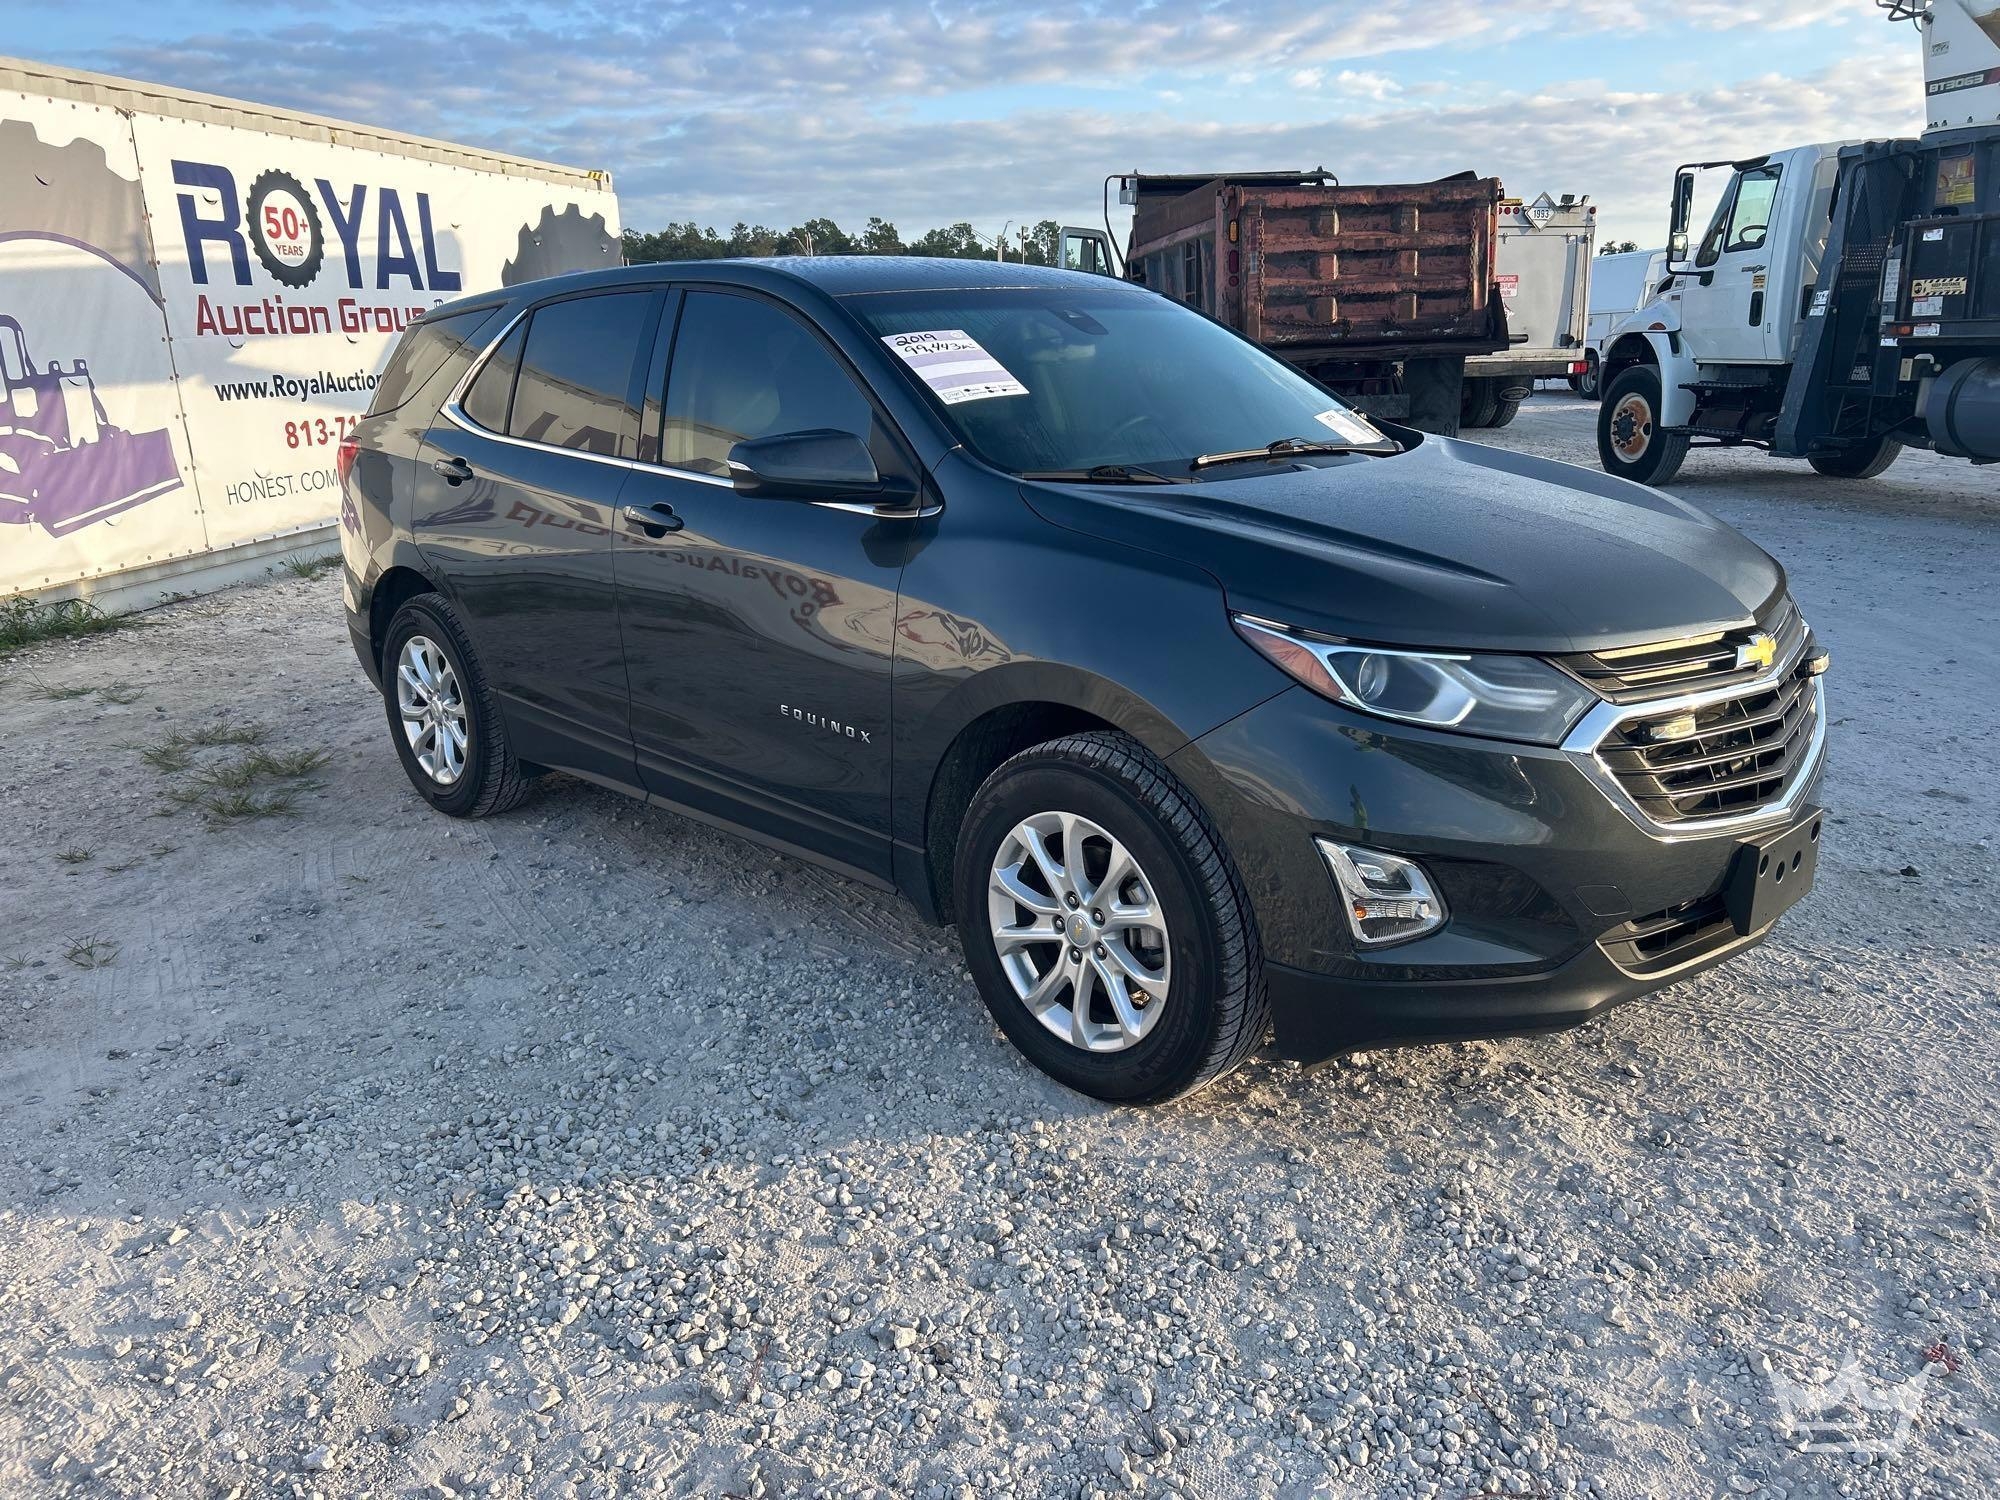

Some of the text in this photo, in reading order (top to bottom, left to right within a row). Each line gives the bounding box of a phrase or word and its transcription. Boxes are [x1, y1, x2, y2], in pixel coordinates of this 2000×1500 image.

[171, 159, 462, 291] ROYAL
[264, 206, 308, 240] 50+
[1533, 209, 1549, 218] 1993
[275, 244, 304, 256] YEARS
[197, 294, 332, 336] Auction
[895, 333, 937, 346] 2019
[226, 475, 299, 505] HONEST.
[780, 704, 871, 744] EQUINOX
